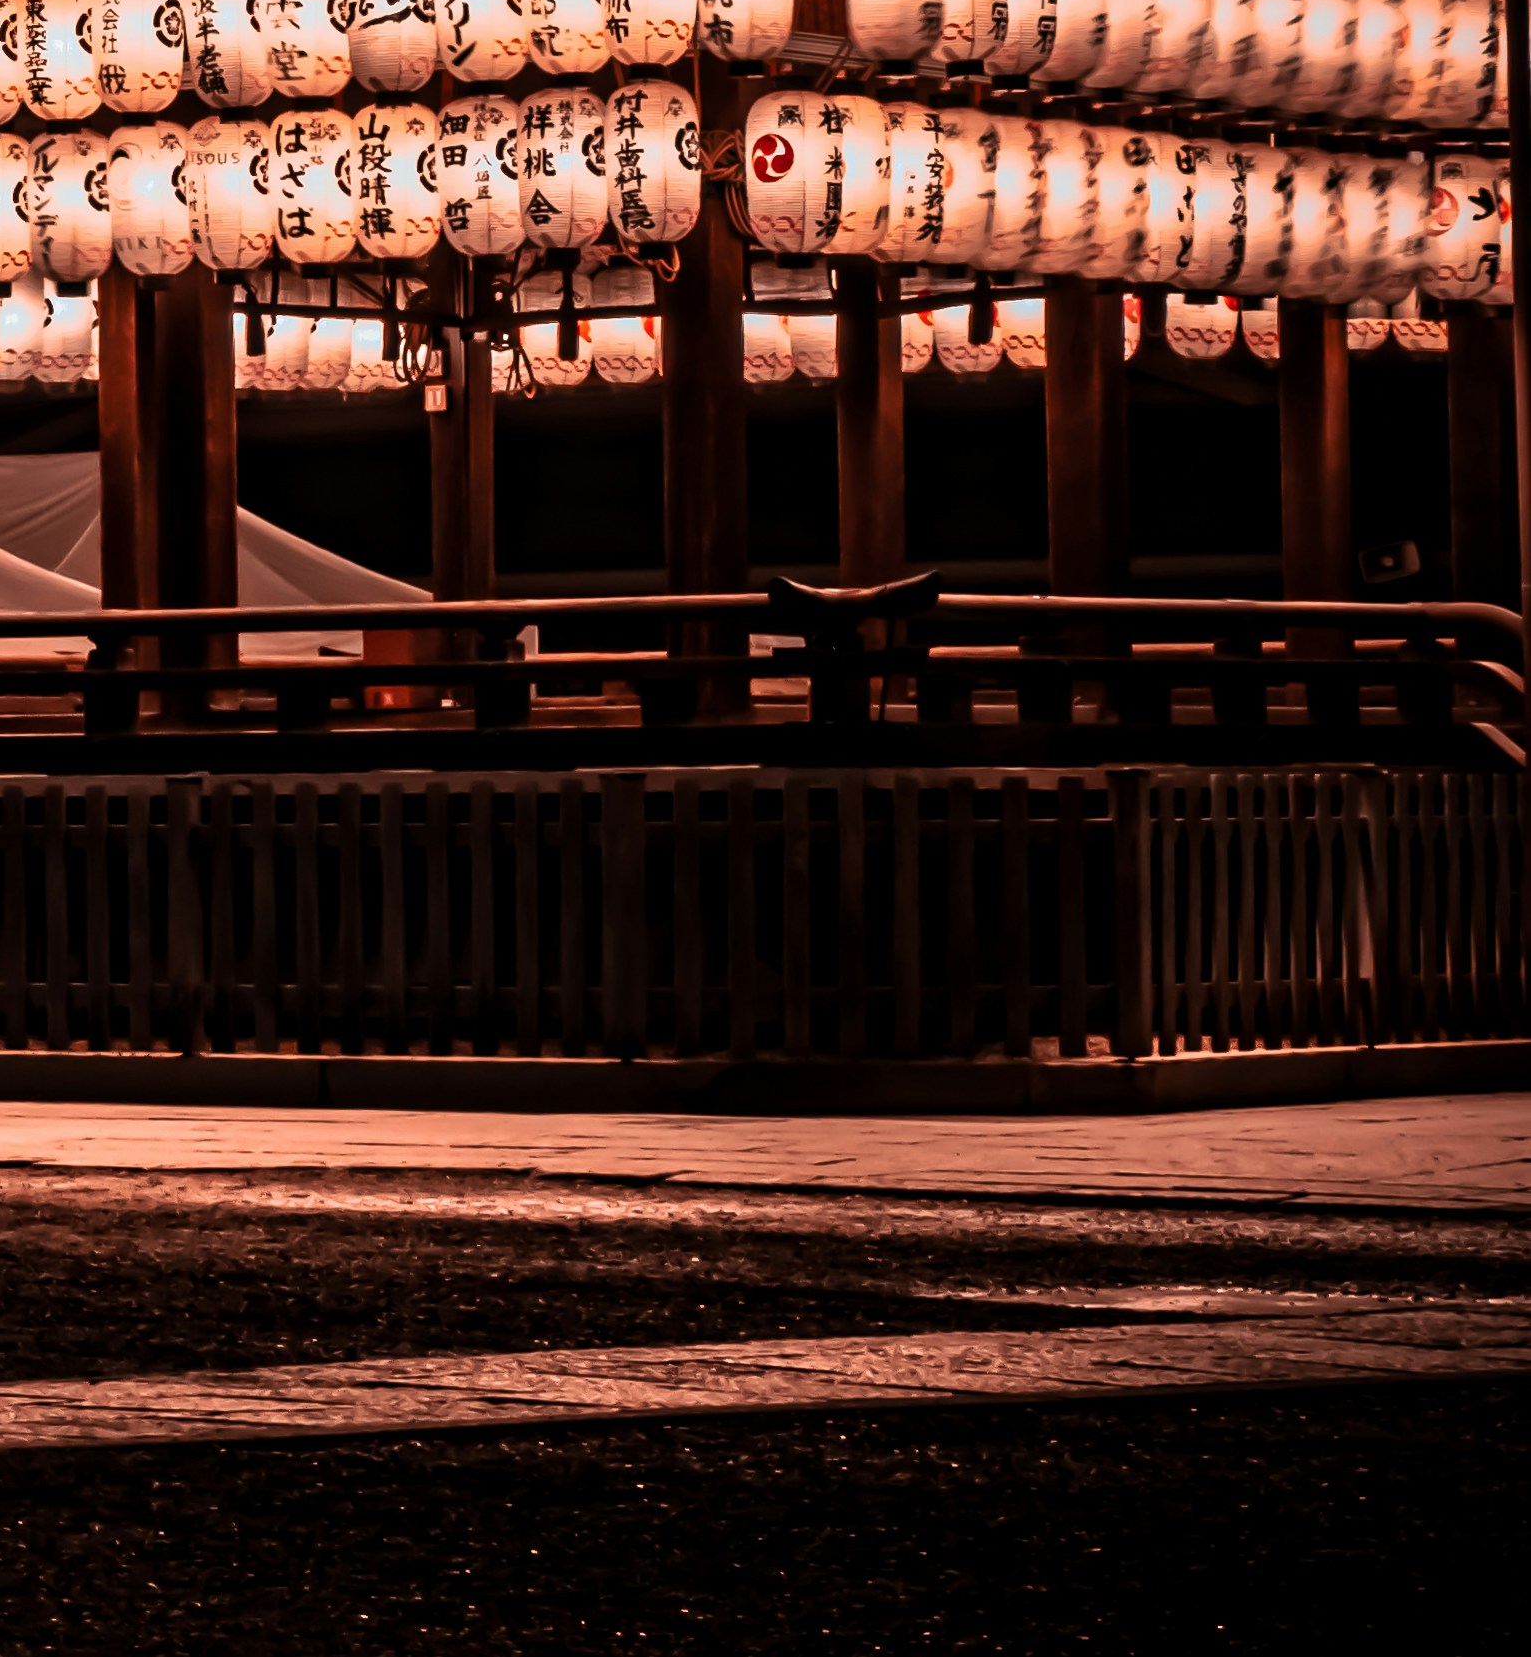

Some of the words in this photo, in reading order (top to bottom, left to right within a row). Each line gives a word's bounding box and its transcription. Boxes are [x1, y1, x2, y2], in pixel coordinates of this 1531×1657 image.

[612, 90, 655, 230] 村井歯科医院
